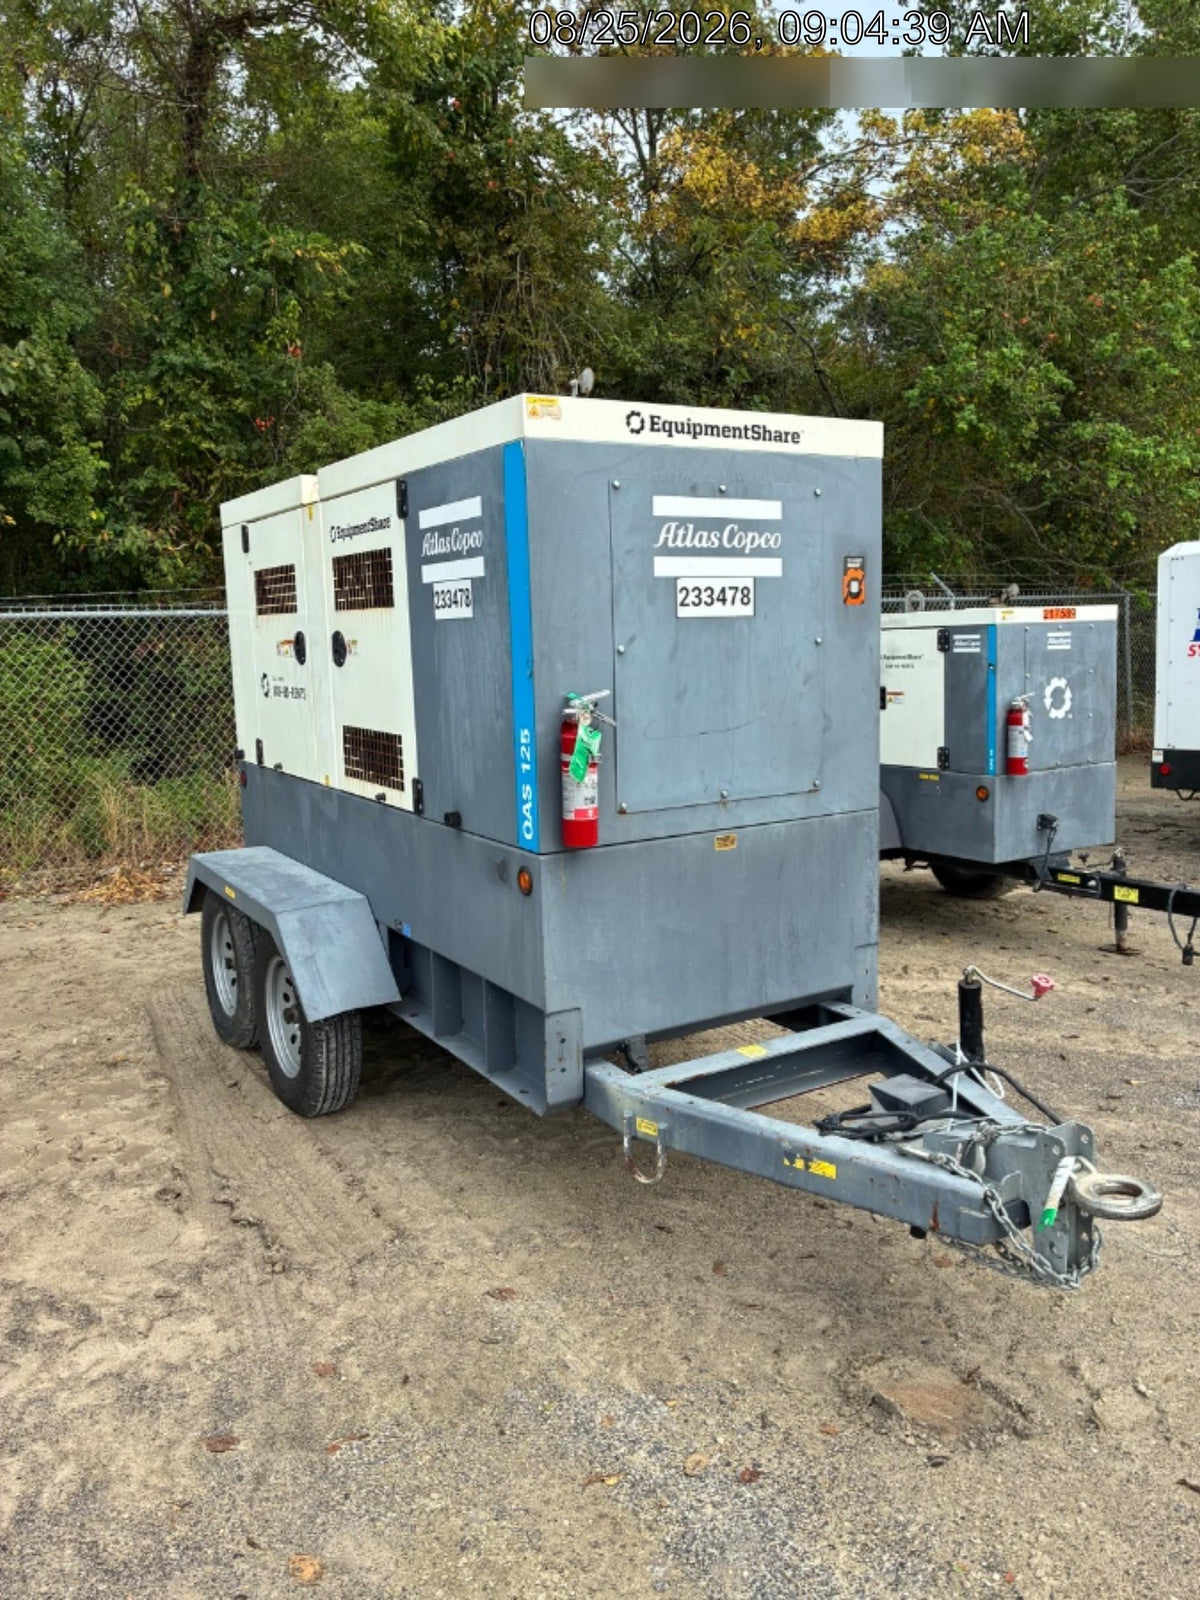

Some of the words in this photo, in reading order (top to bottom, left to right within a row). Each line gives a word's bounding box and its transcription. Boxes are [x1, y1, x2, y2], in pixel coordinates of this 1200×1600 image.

[649, 414, 801, 445] EquipmentShare
[420, 531, 450, 557] Atlas
[450, 527, 483, 556] Copco
[652, 521, 720, 549] Atlas
[721, 523, 782, 554] Copco
[434, 587, 472, 609] 233478
[678, 586, 752, 607] 233478
[520, 728, 532, 774] 125
